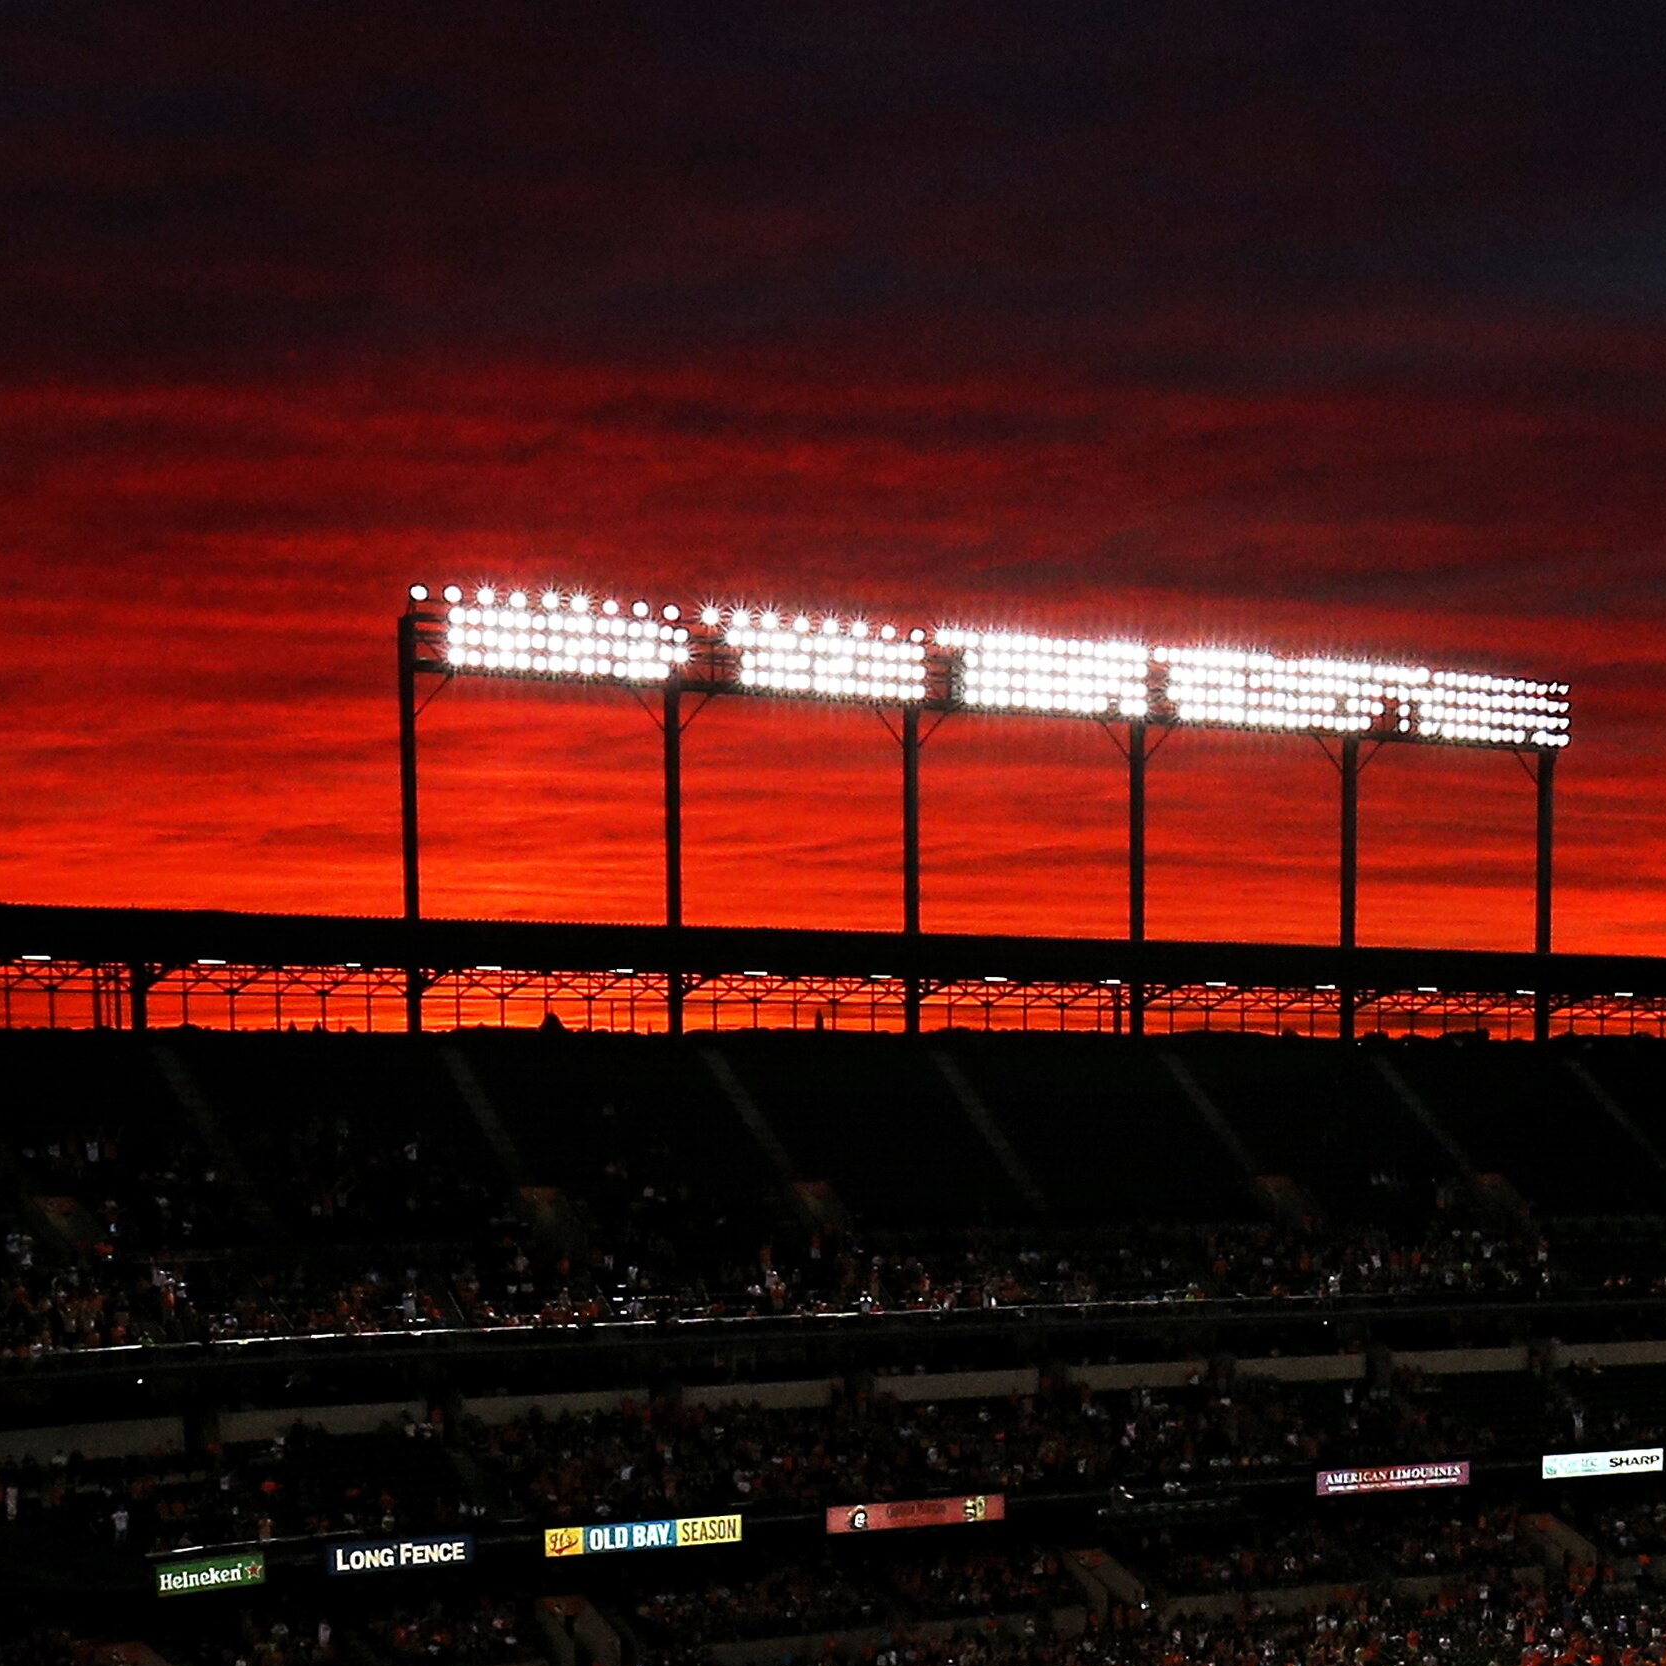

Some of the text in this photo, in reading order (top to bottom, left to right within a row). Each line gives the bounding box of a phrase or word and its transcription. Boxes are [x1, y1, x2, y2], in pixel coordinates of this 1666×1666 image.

[1325, 1471, 1388, 1485] AMERICAN
[1389, 1465, 1461, 1480] LIMOUSINES
[1609, 1455, 1660, 1468] SHARP
[589, 1525, 629, 1550] OLD
[681, 1518, 737, 1543] SEASON
[335, 1541, 466, 1572] LONG FENCE
[159, 1562, 242, 1592] Heineken
